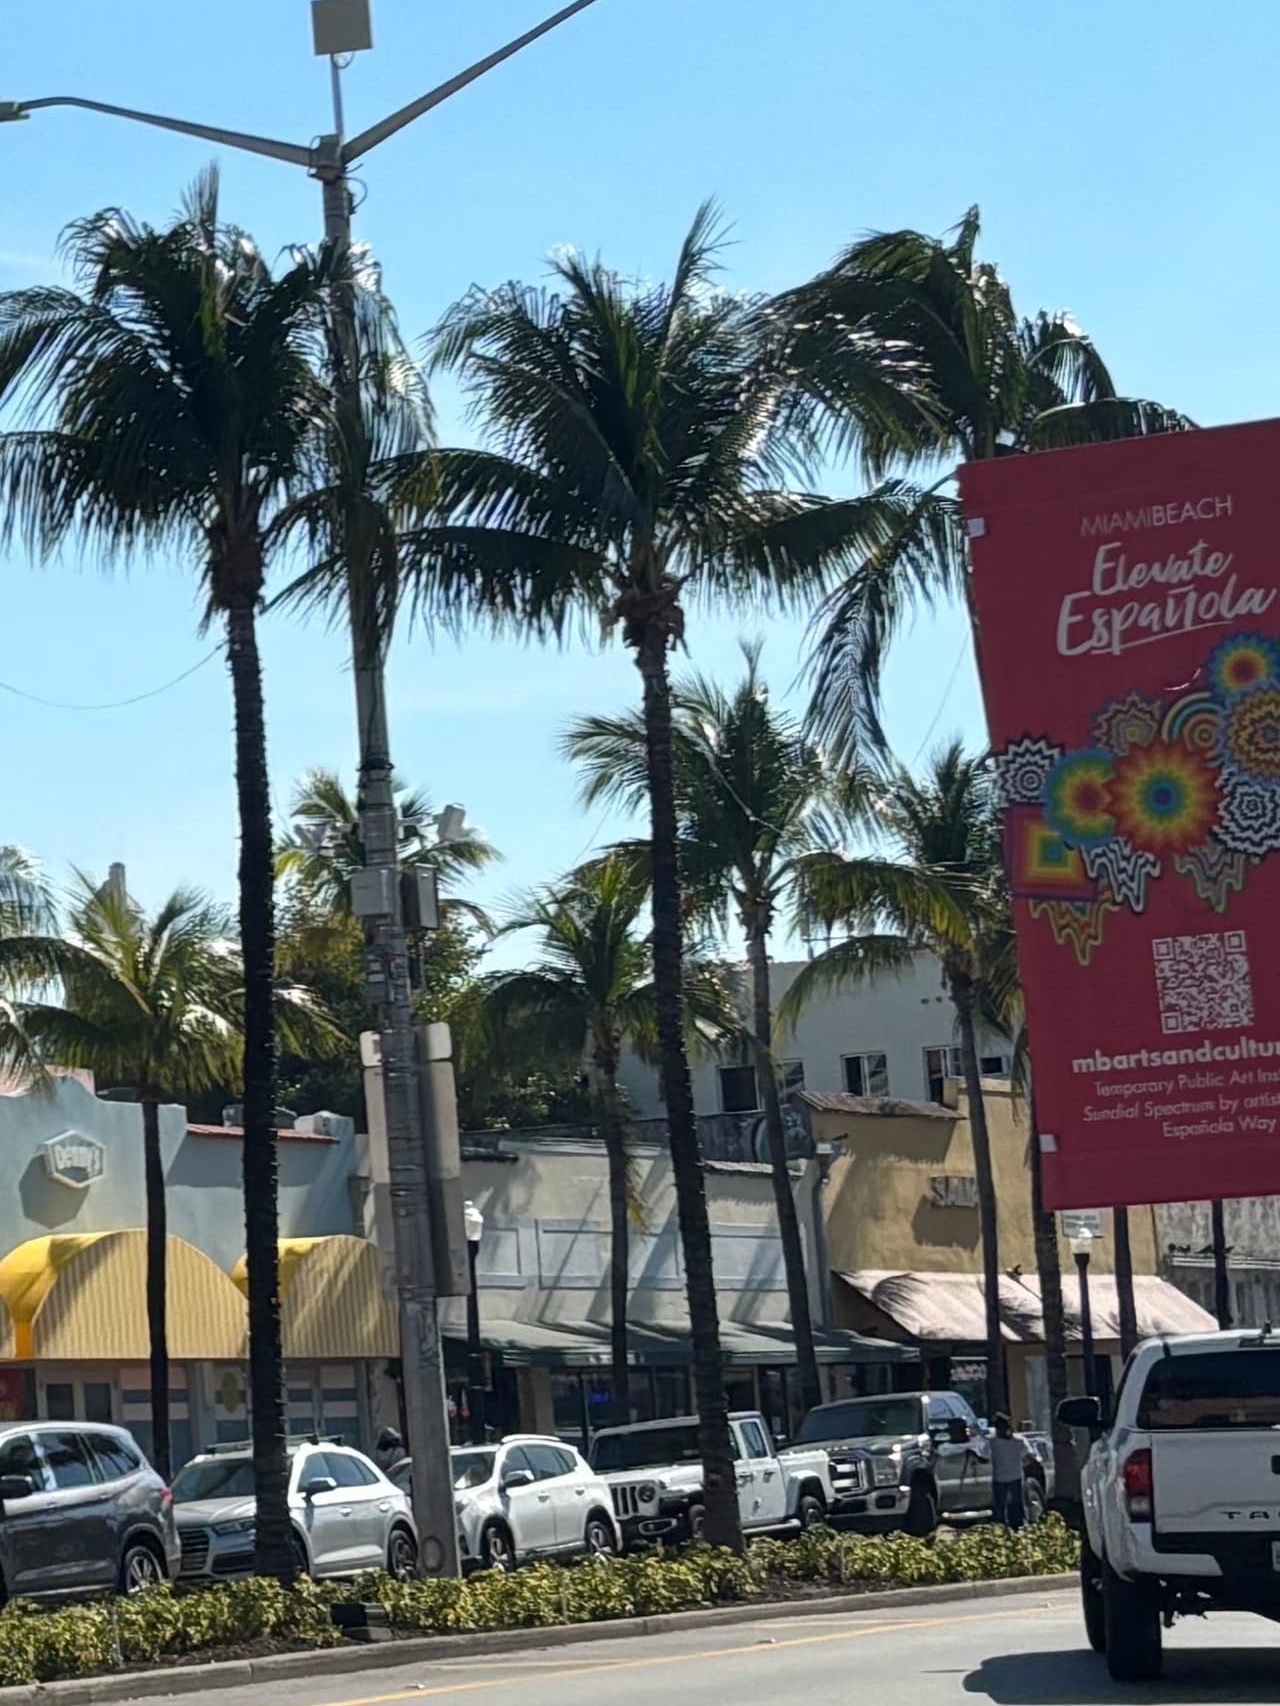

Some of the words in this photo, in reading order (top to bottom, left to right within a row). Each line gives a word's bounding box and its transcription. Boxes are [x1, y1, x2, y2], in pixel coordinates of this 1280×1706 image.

[1081, 494, 1233, 538] MIAMIBEACH
[1092, 539, 1233, 596] Elevate
[1056, 573, 1278, 656] Española
[1094, 1079, 1174, 1098] Temporary
[1178, 1071, 1224, 1090] Public
[1230, 1069, 1253, 1085] Art
[1083, 1101, 1139, 1121] Sundial
[1144, 1098, 1214, 1120] Spectrum
[1219, 1094, 1239, 1113] by
[1163, 1116, 1234, 1139] Española
[1238, 1116, 1276, 1134] Way
[1220, 1510, 1280, 1520] TA
